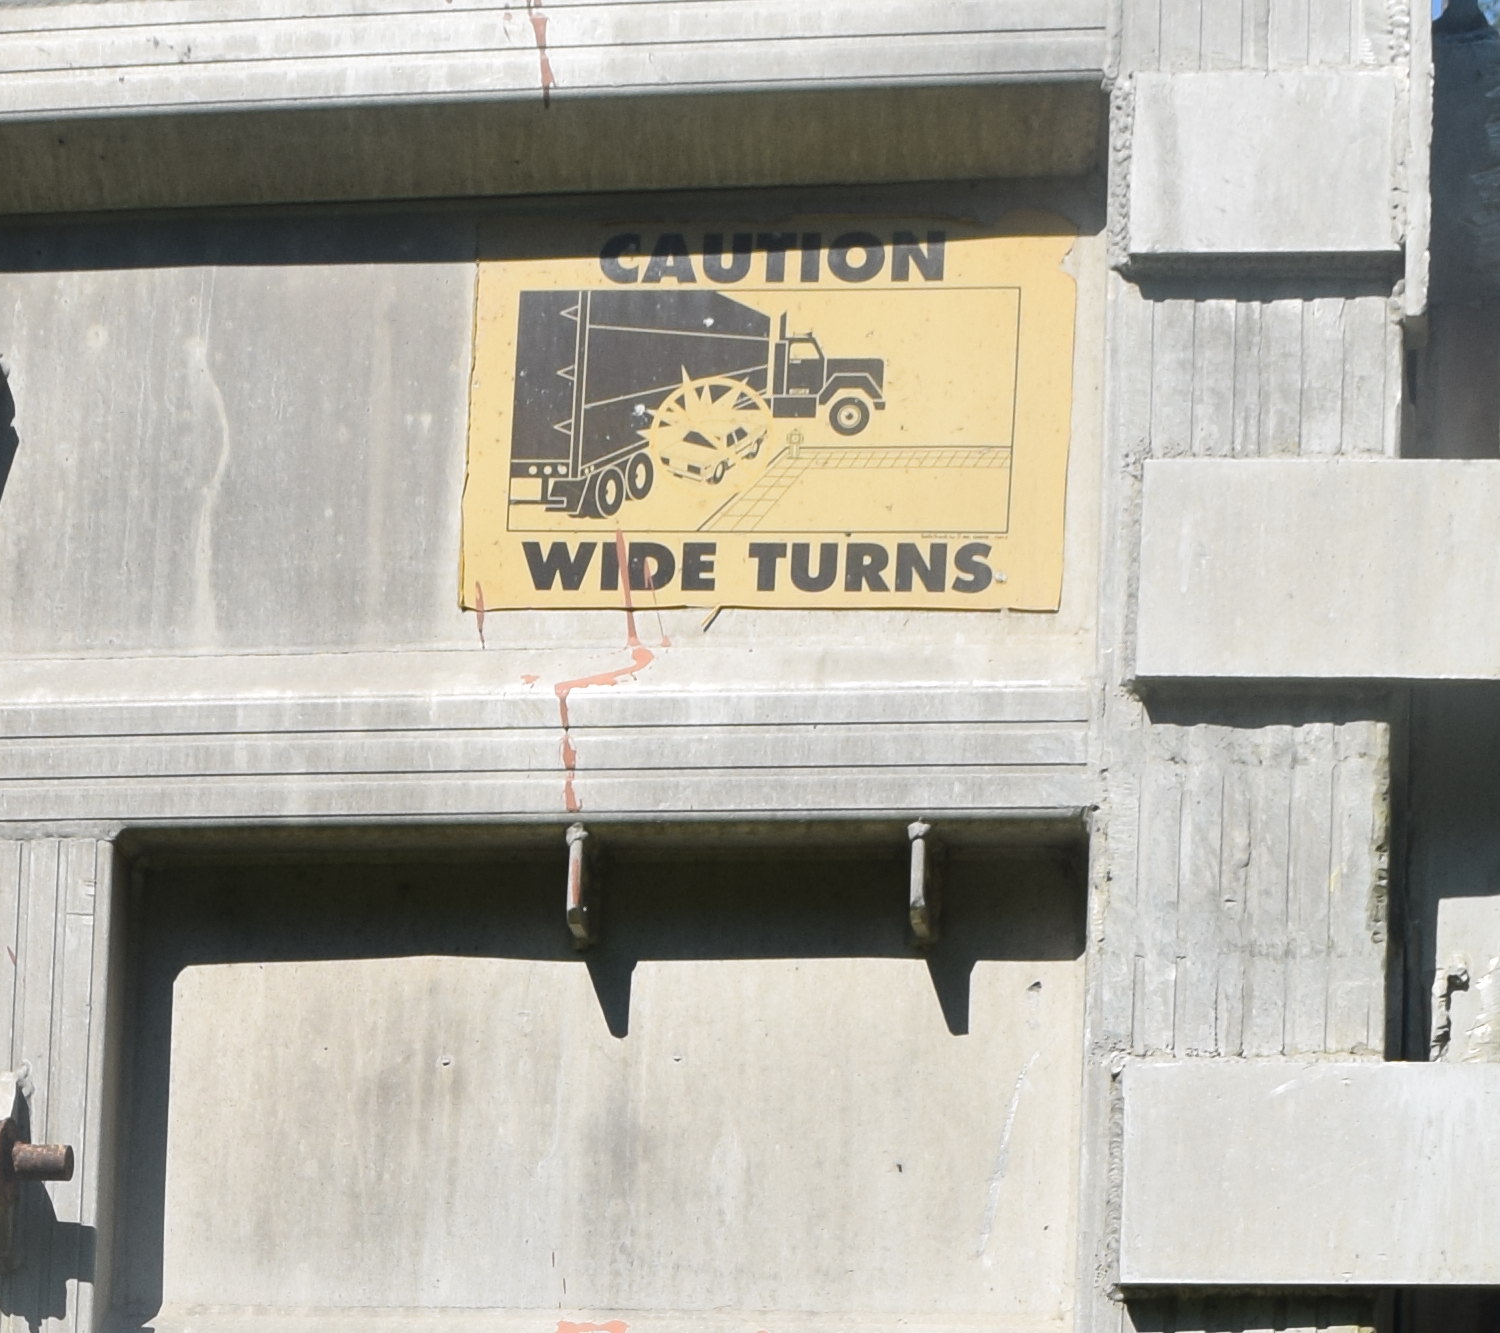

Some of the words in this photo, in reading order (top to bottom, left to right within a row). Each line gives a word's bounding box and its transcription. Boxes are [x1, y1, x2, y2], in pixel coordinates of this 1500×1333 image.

[598, 230, 946, 284] CAUTION
[522, 540, 718, 592] WIDE
[748, 541, 994, 594] TURNS
